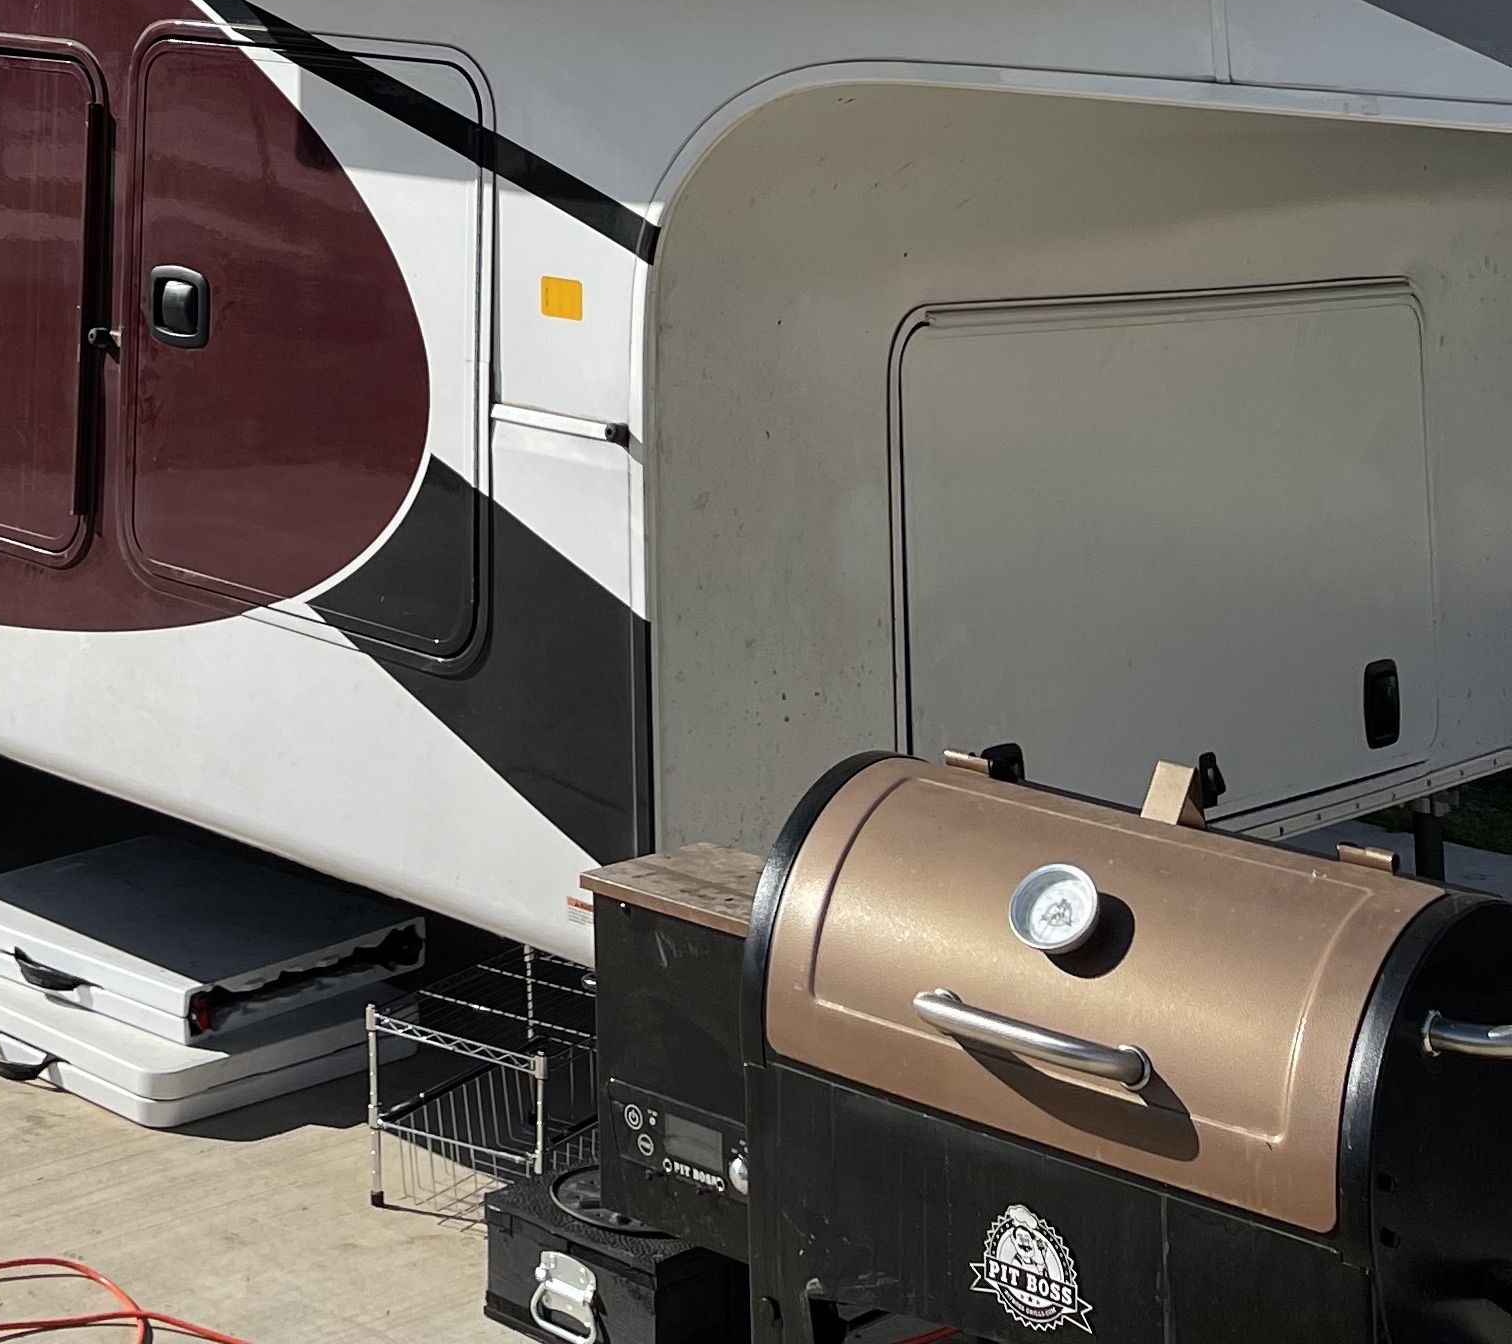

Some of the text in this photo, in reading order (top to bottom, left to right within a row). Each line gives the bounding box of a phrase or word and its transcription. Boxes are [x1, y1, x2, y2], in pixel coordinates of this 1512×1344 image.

[673, 1161, 691, 1178] PIT
[988, 1259, 1020, 1286] PIT
[1026, 1273, 1073, 1306] BOSS
